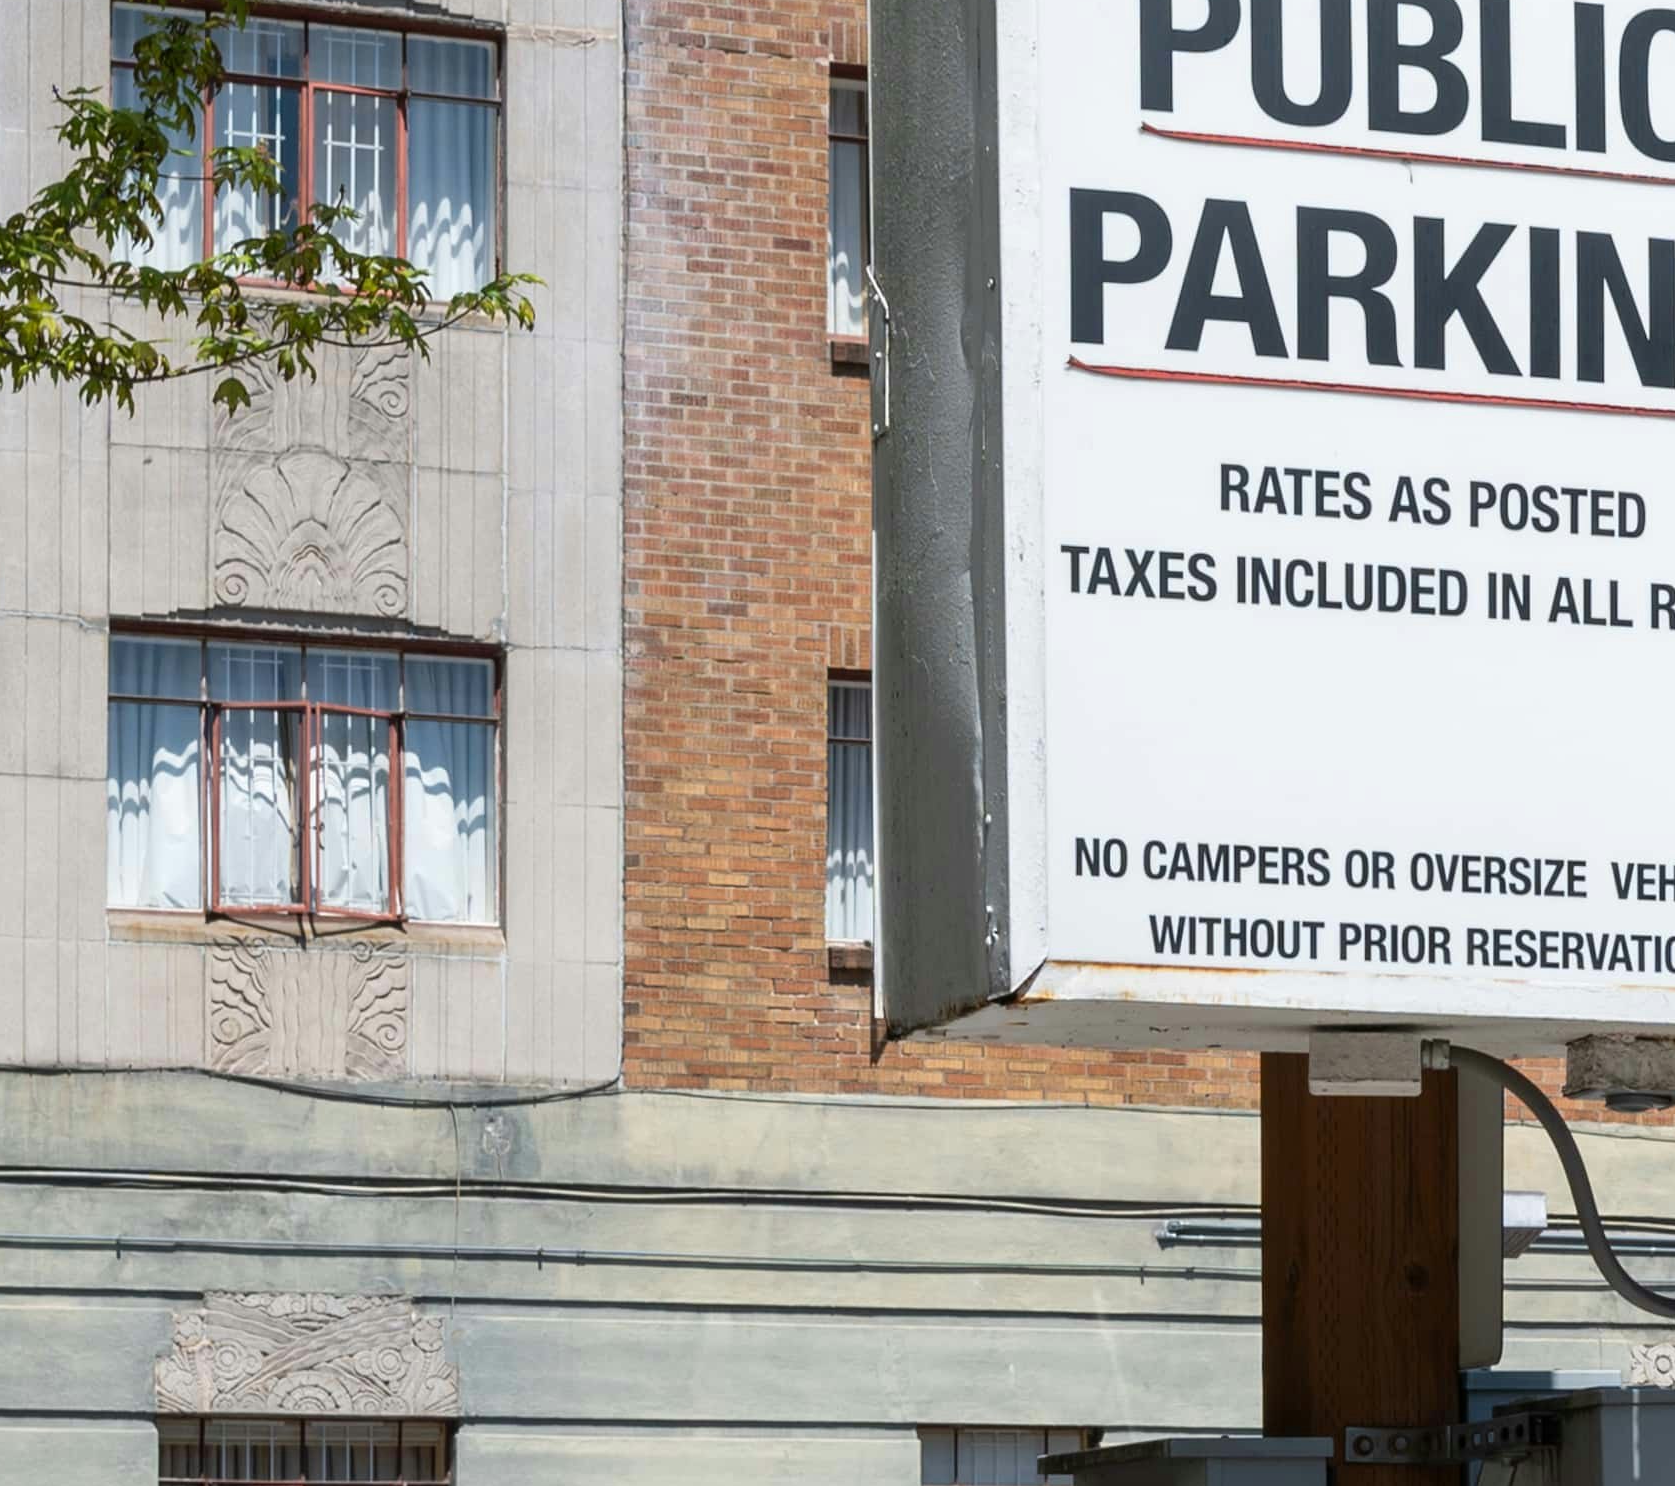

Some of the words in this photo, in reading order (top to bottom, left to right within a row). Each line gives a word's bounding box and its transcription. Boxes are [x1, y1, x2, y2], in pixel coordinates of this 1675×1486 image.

[1221, 464, 1371, 520] RATES
[1389, 476, 1451, 525] AS
[1470, 481, 1645, 538] POSTED
[1061, 545, 1216, 601] TAXES
[1237, 557, 1467, 616] INCLUDED
[1489, 573, 1530, 620] IN
[1549, 578, 1633, 627] ALL
[1076, 838, 1127, 878] NO
[1144, 841, 1330, 886] CAMPERS
[1346, 850, 1395, 889] OR
[1411, 853, 1587, 897] OVERSIZE
[1149, 915, 1324, 959] WITHOUT
[1340, 923, 1451, 964] PRIOR
